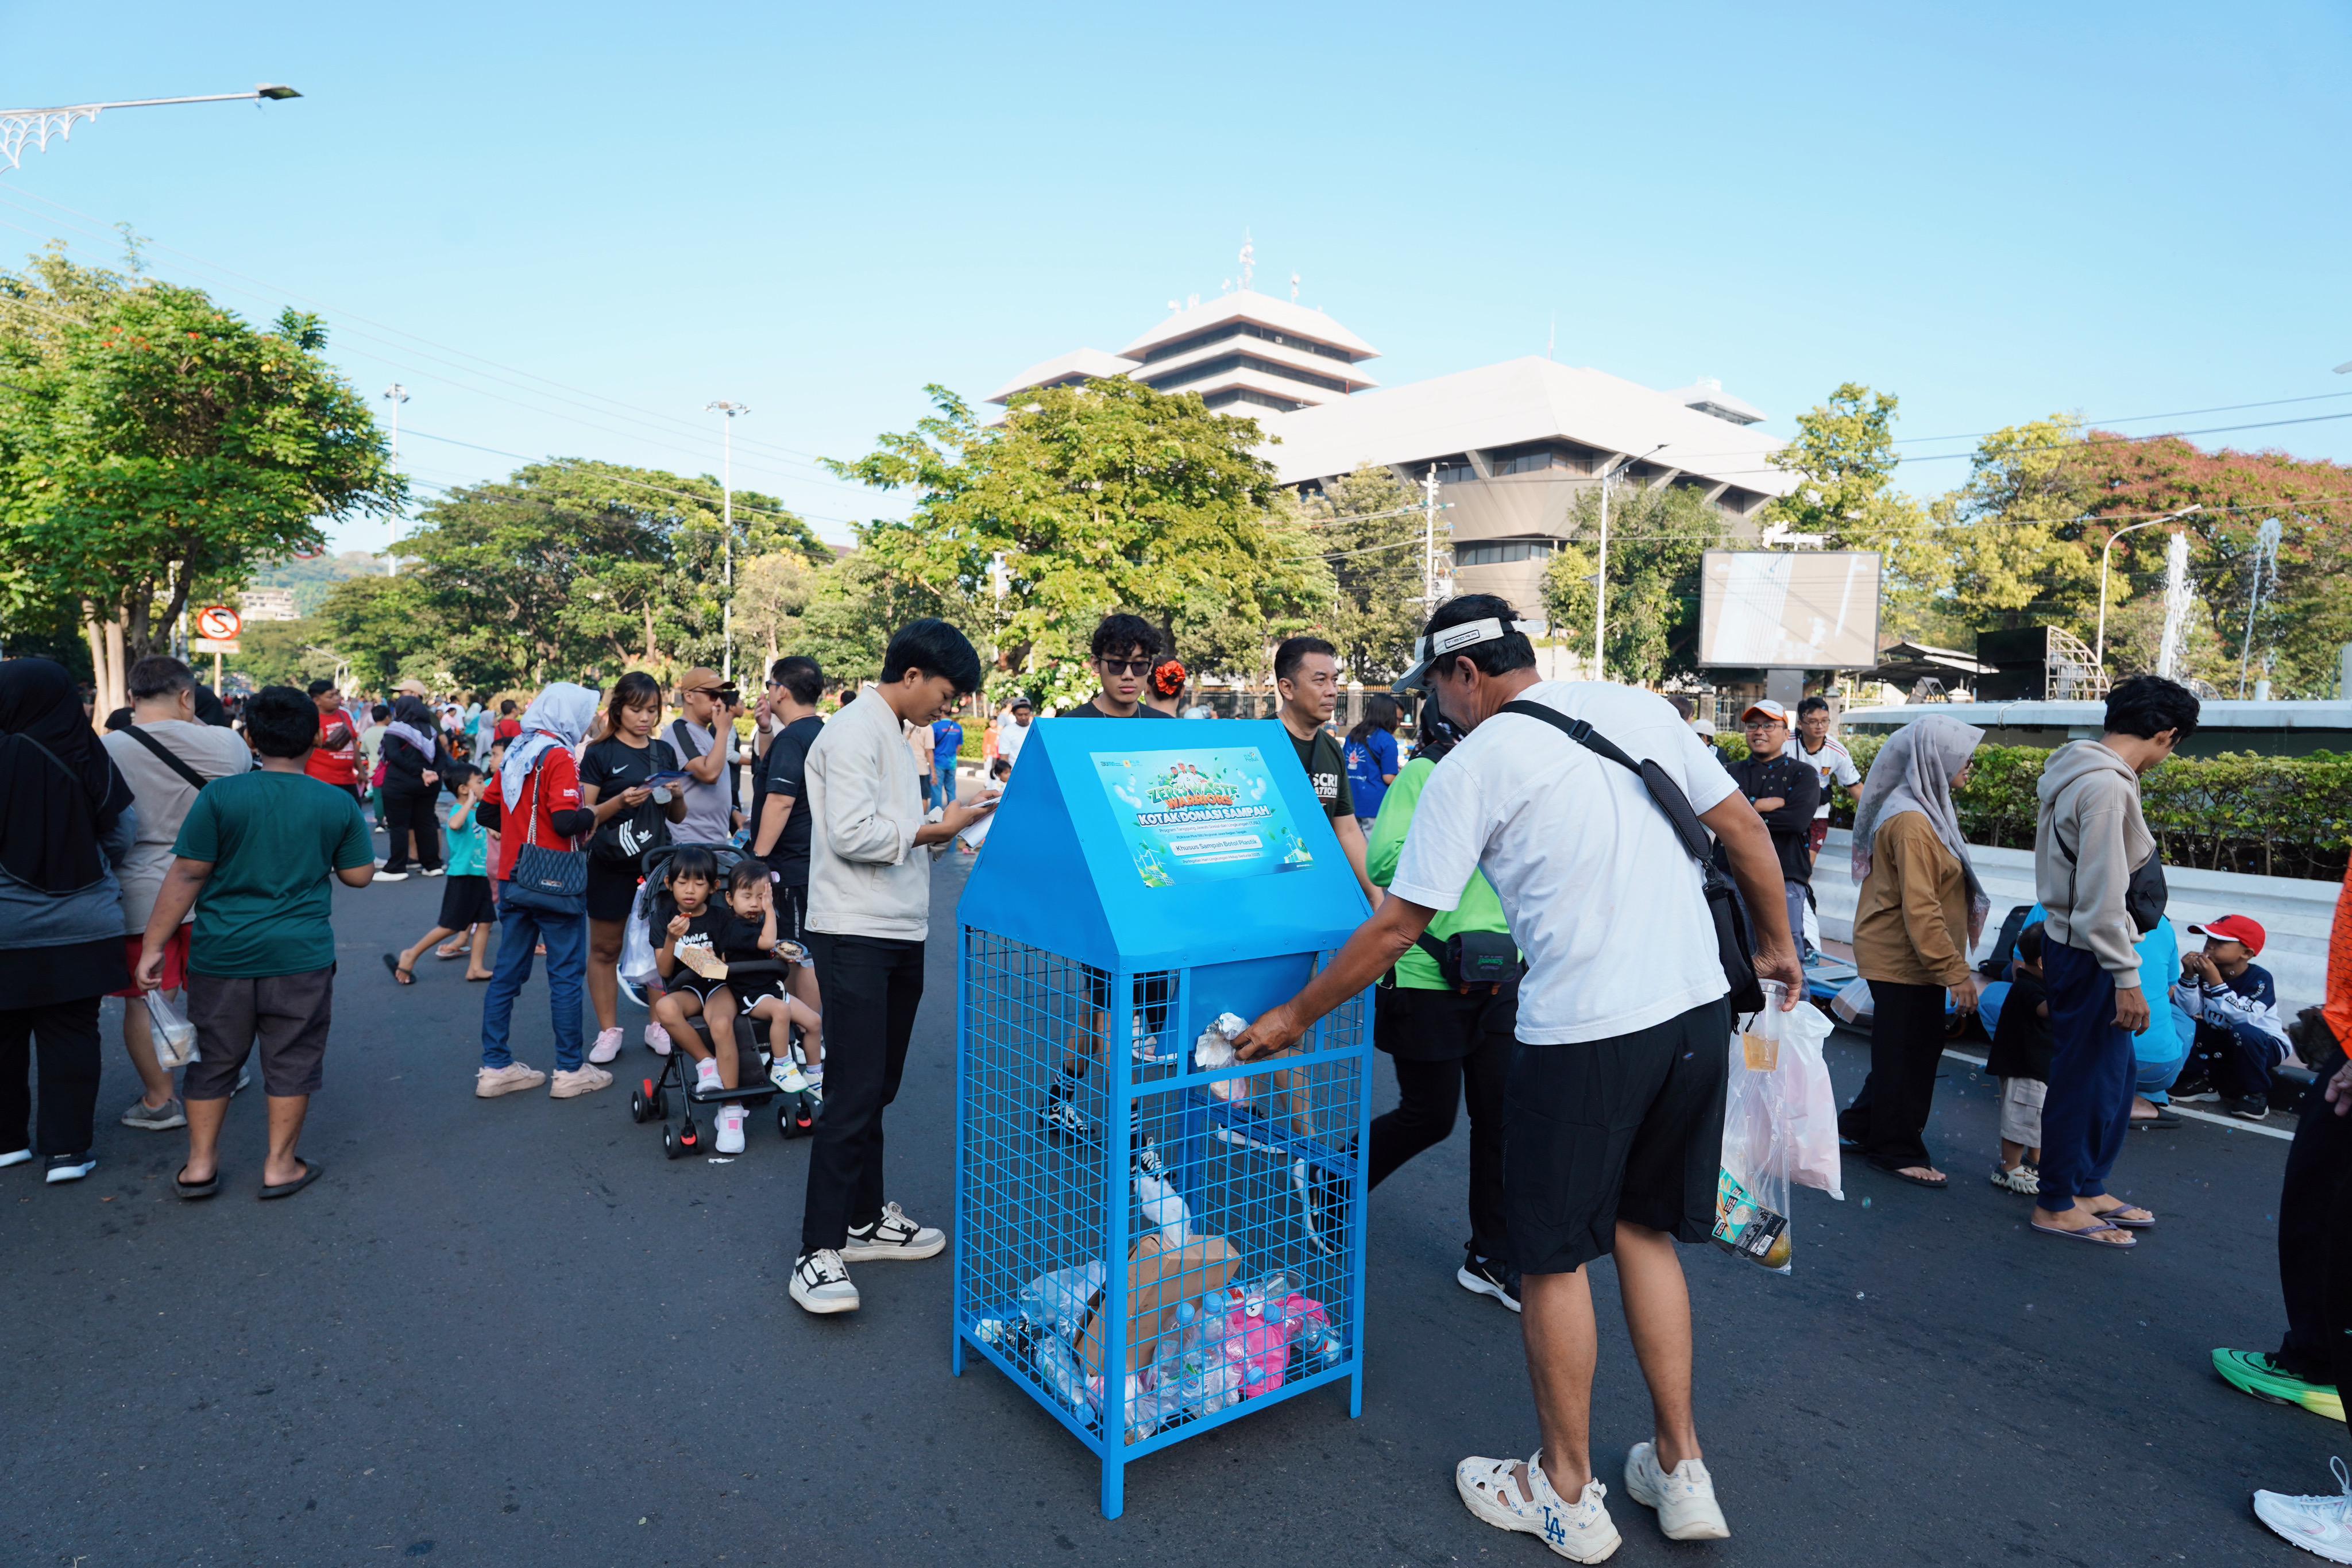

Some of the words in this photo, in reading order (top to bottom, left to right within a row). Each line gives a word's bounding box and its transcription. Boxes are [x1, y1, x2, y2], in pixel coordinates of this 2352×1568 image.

[1147, 783, 1188, 804] ZERO
[1188, 782, 1239, 797] WASTE
[1165, 794, 1233, 809] WARRIORS
[1137, 812, 1183, 825] KOTAK
[1179, 808, 1224, 822] DONASI
[1222, 805, 1271, 819] SAMPAH
[1543, 1505, 1565, 1546] LA
